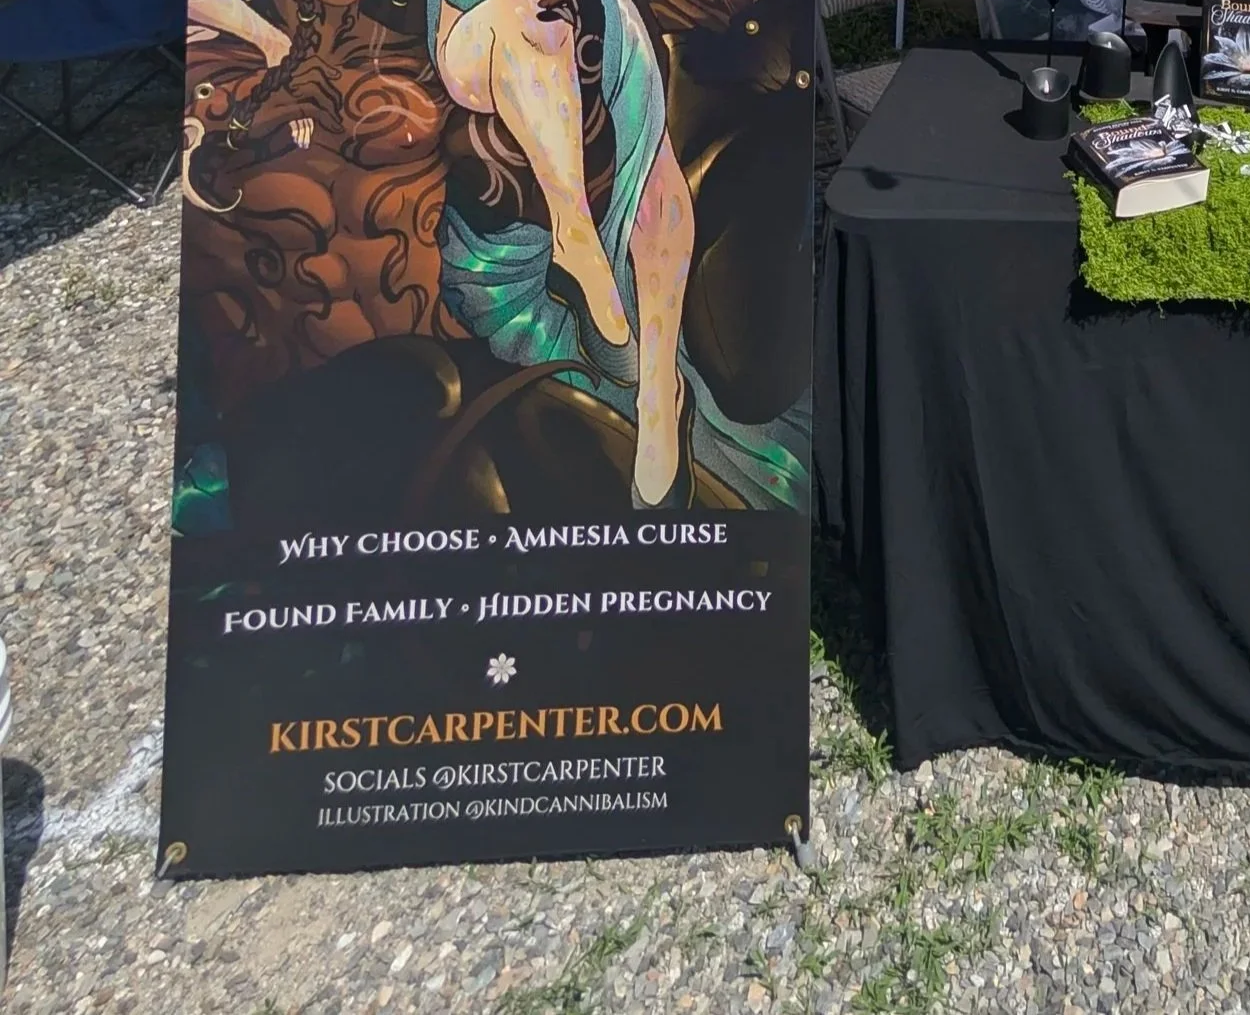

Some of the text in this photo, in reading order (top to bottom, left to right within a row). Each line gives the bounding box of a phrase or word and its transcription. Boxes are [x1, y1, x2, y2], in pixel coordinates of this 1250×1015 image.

[1091, 128, 1162, 150] Shadows
[279, 523, 728, 566] WHY CHOOSE AMNESIA CURSE
[223, 589, 772, 634] FOUND FAMILY HIDDEN PREGNANCY
[269, 703, 723, 754] KIRSTCARPENTER.COM
[323, 755, 667, 795] SOCIALS @KIRSTCARPENTER
[316, 791, 668, 829] ILLUSTRATION @KINDCANNIBALISM
